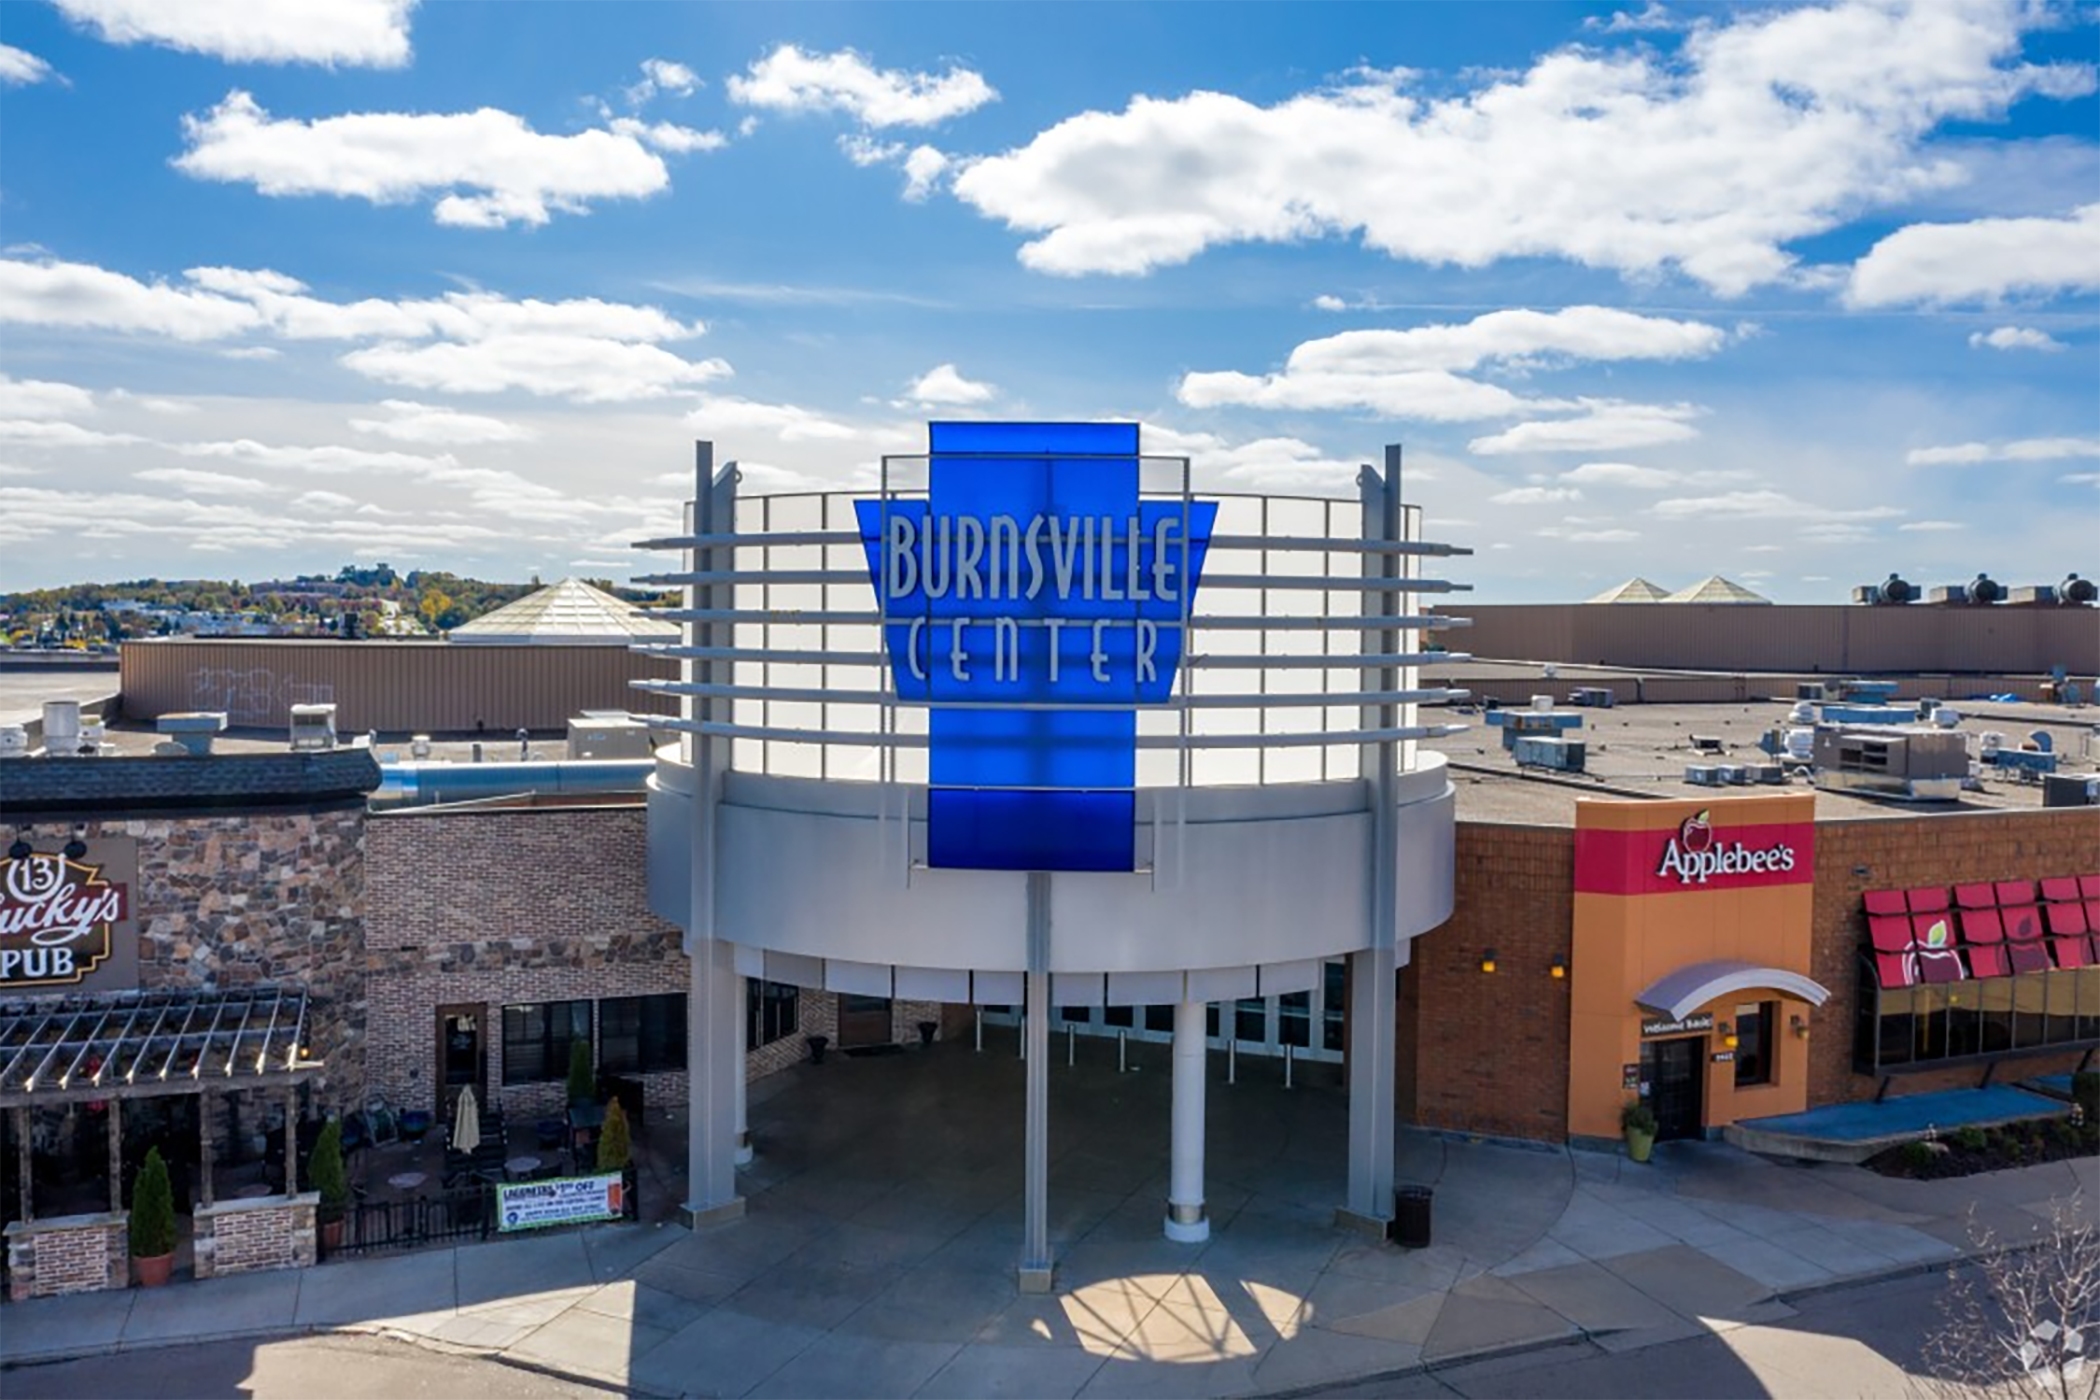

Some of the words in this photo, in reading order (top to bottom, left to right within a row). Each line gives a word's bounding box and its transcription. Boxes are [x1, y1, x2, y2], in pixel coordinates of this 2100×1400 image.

[888, 514, 1179, 600] BURNSVILLE
[908, 616, 1157, 683] CENTER
[20, 857, 54, 892] 13
[1656, 838, 1795, 884] Applebee's
[0, 883, 119, 946] ucky's
[0, 947, 75, 979] PUB
